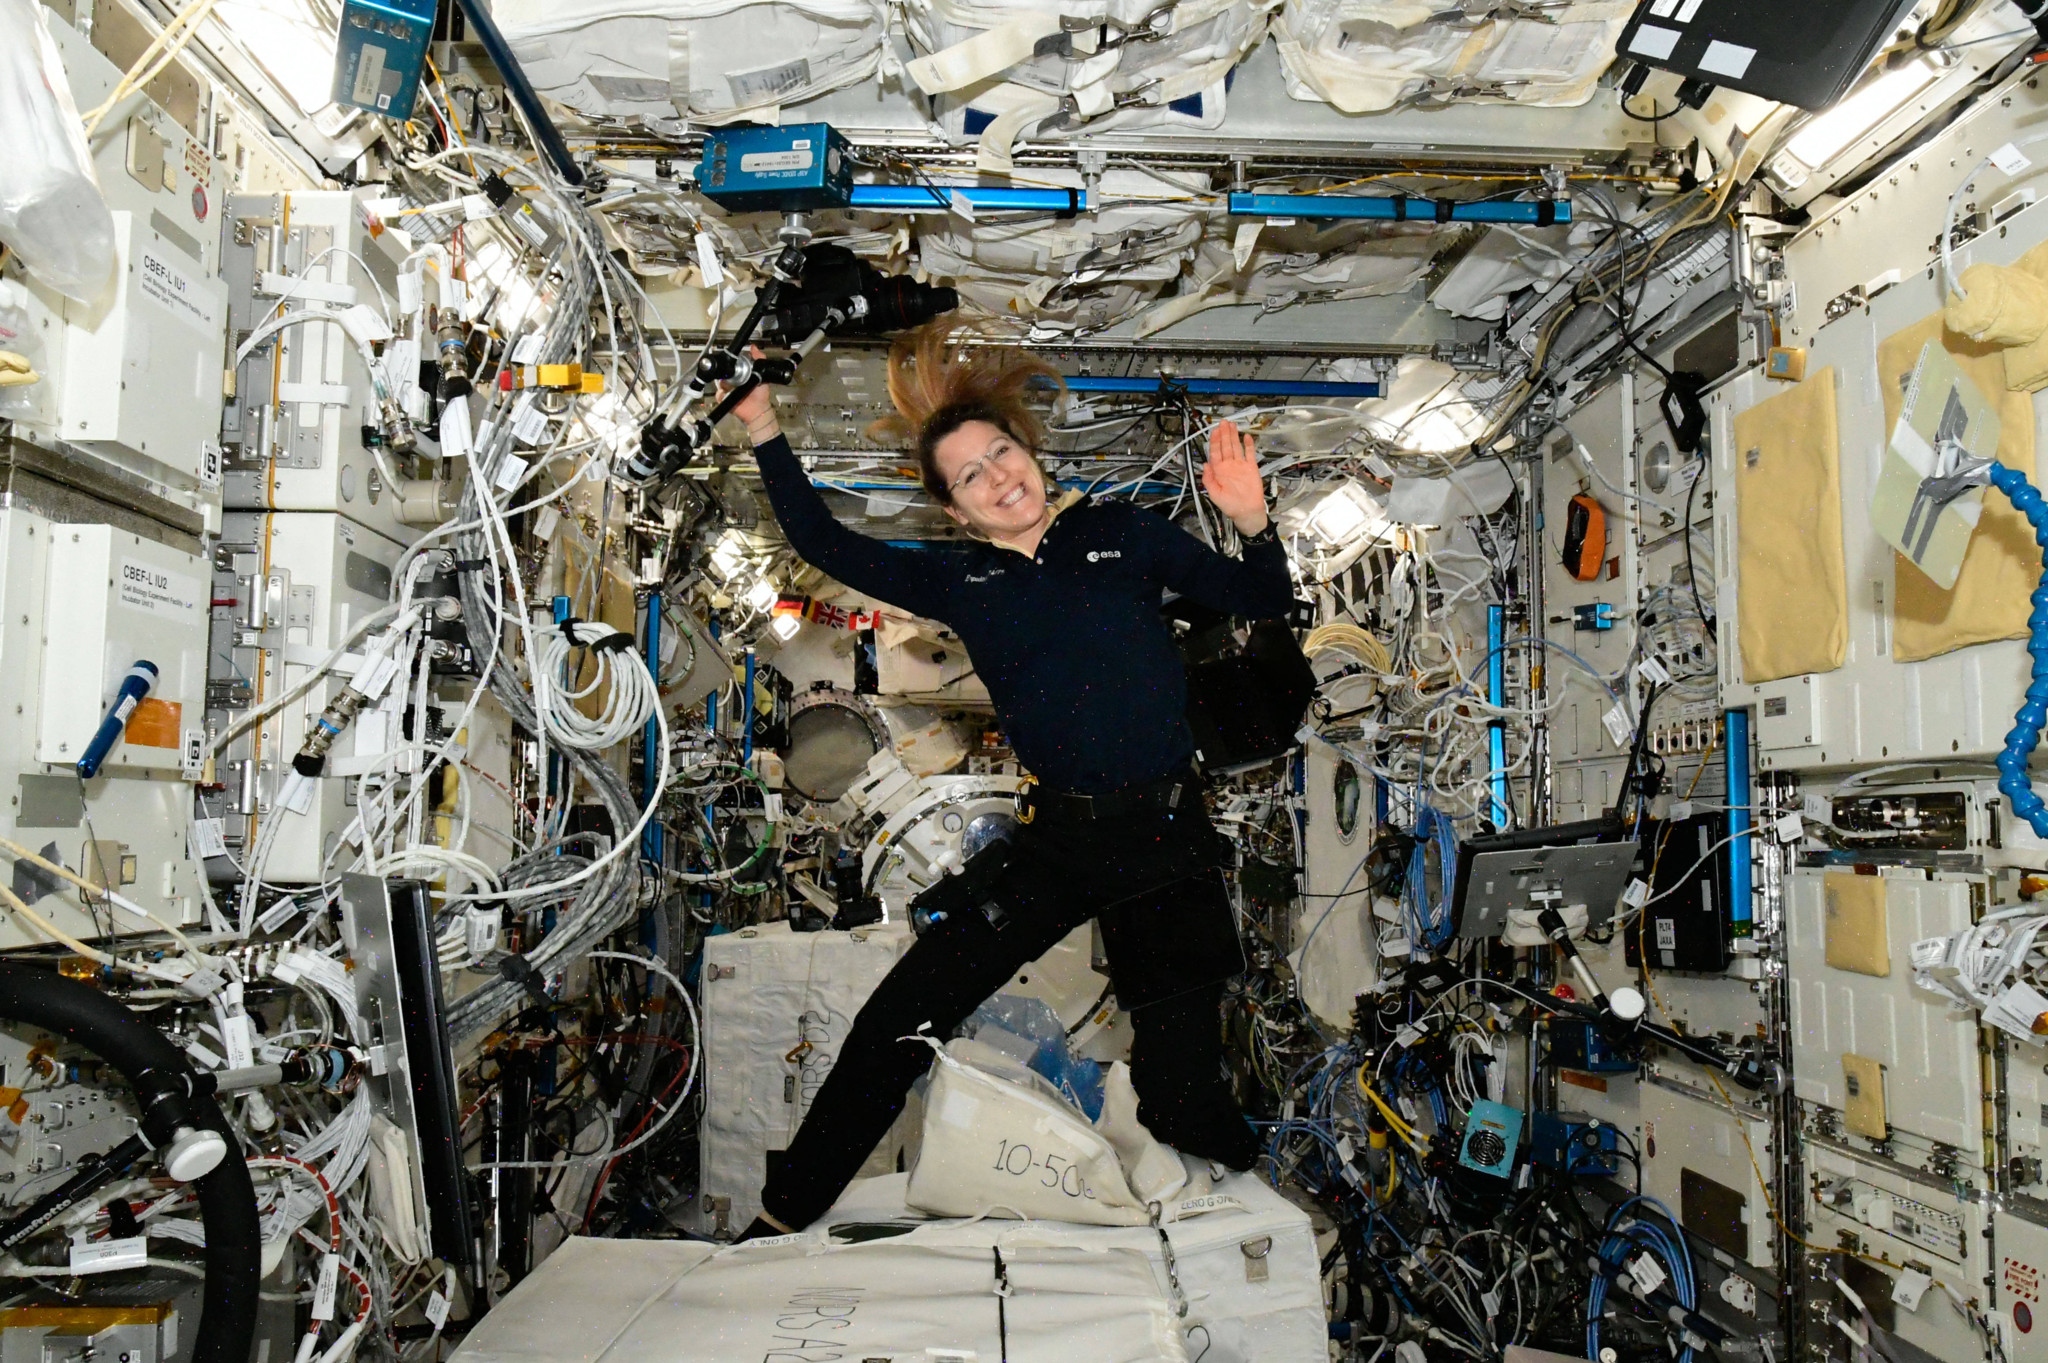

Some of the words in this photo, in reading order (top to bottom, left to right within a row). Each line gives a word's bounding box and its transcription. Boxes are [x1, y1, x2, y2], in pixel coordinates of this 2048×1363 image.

[144, 254, 172, 285] CBEF-L
[174, 275, 186, 293] IU1
[123, 564, 152, 585] CBEF-L
[155, 574, 167, 590] IU2
[1658, 922, 1672, 932] PLT4
[1660, 936, 1673, 945] JAXA
[1181, 1198, 1205, 1210] ZERO
[1207, 1197, 1215, 1207] G
[2, 1199, 72, 1247] Manfrotto
[776, 1286, 866, 1330] NORS
